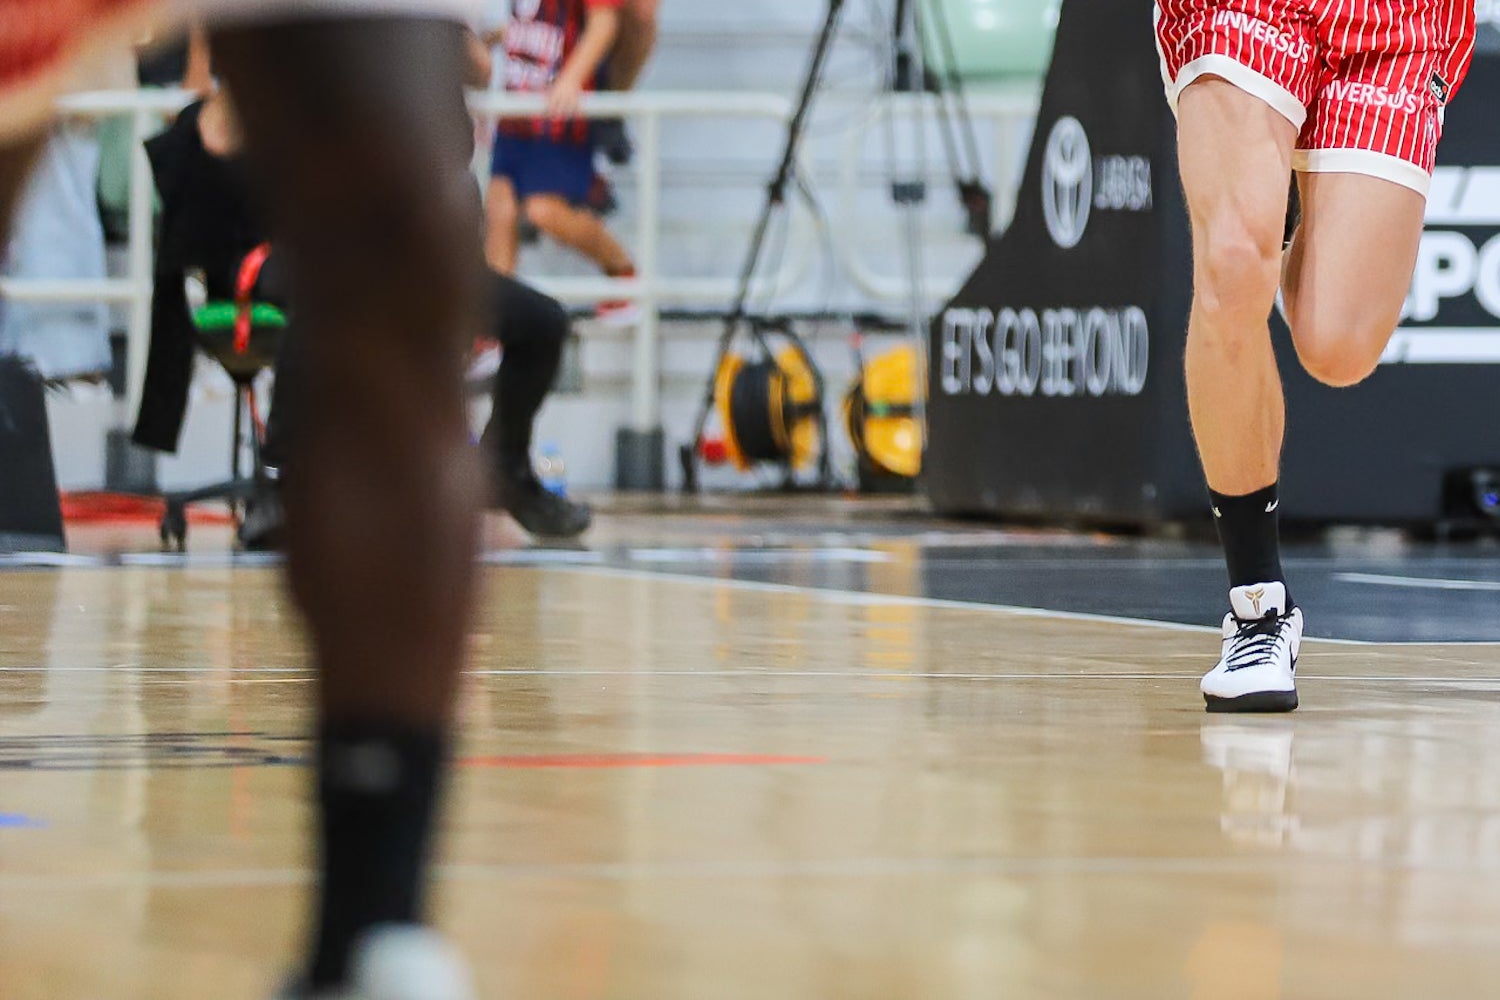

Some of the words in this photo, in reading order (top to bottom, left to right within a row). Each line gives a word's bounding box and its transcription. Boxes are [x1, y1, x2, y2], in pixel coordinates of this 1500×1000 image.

[1217, 10, 1310, 64] INVERSUS
[1321, 79, 1418, 115] NVERSUS
[994, 306, 1041, 397] GO
[1041, 306, 1149, 397] BEYOND
